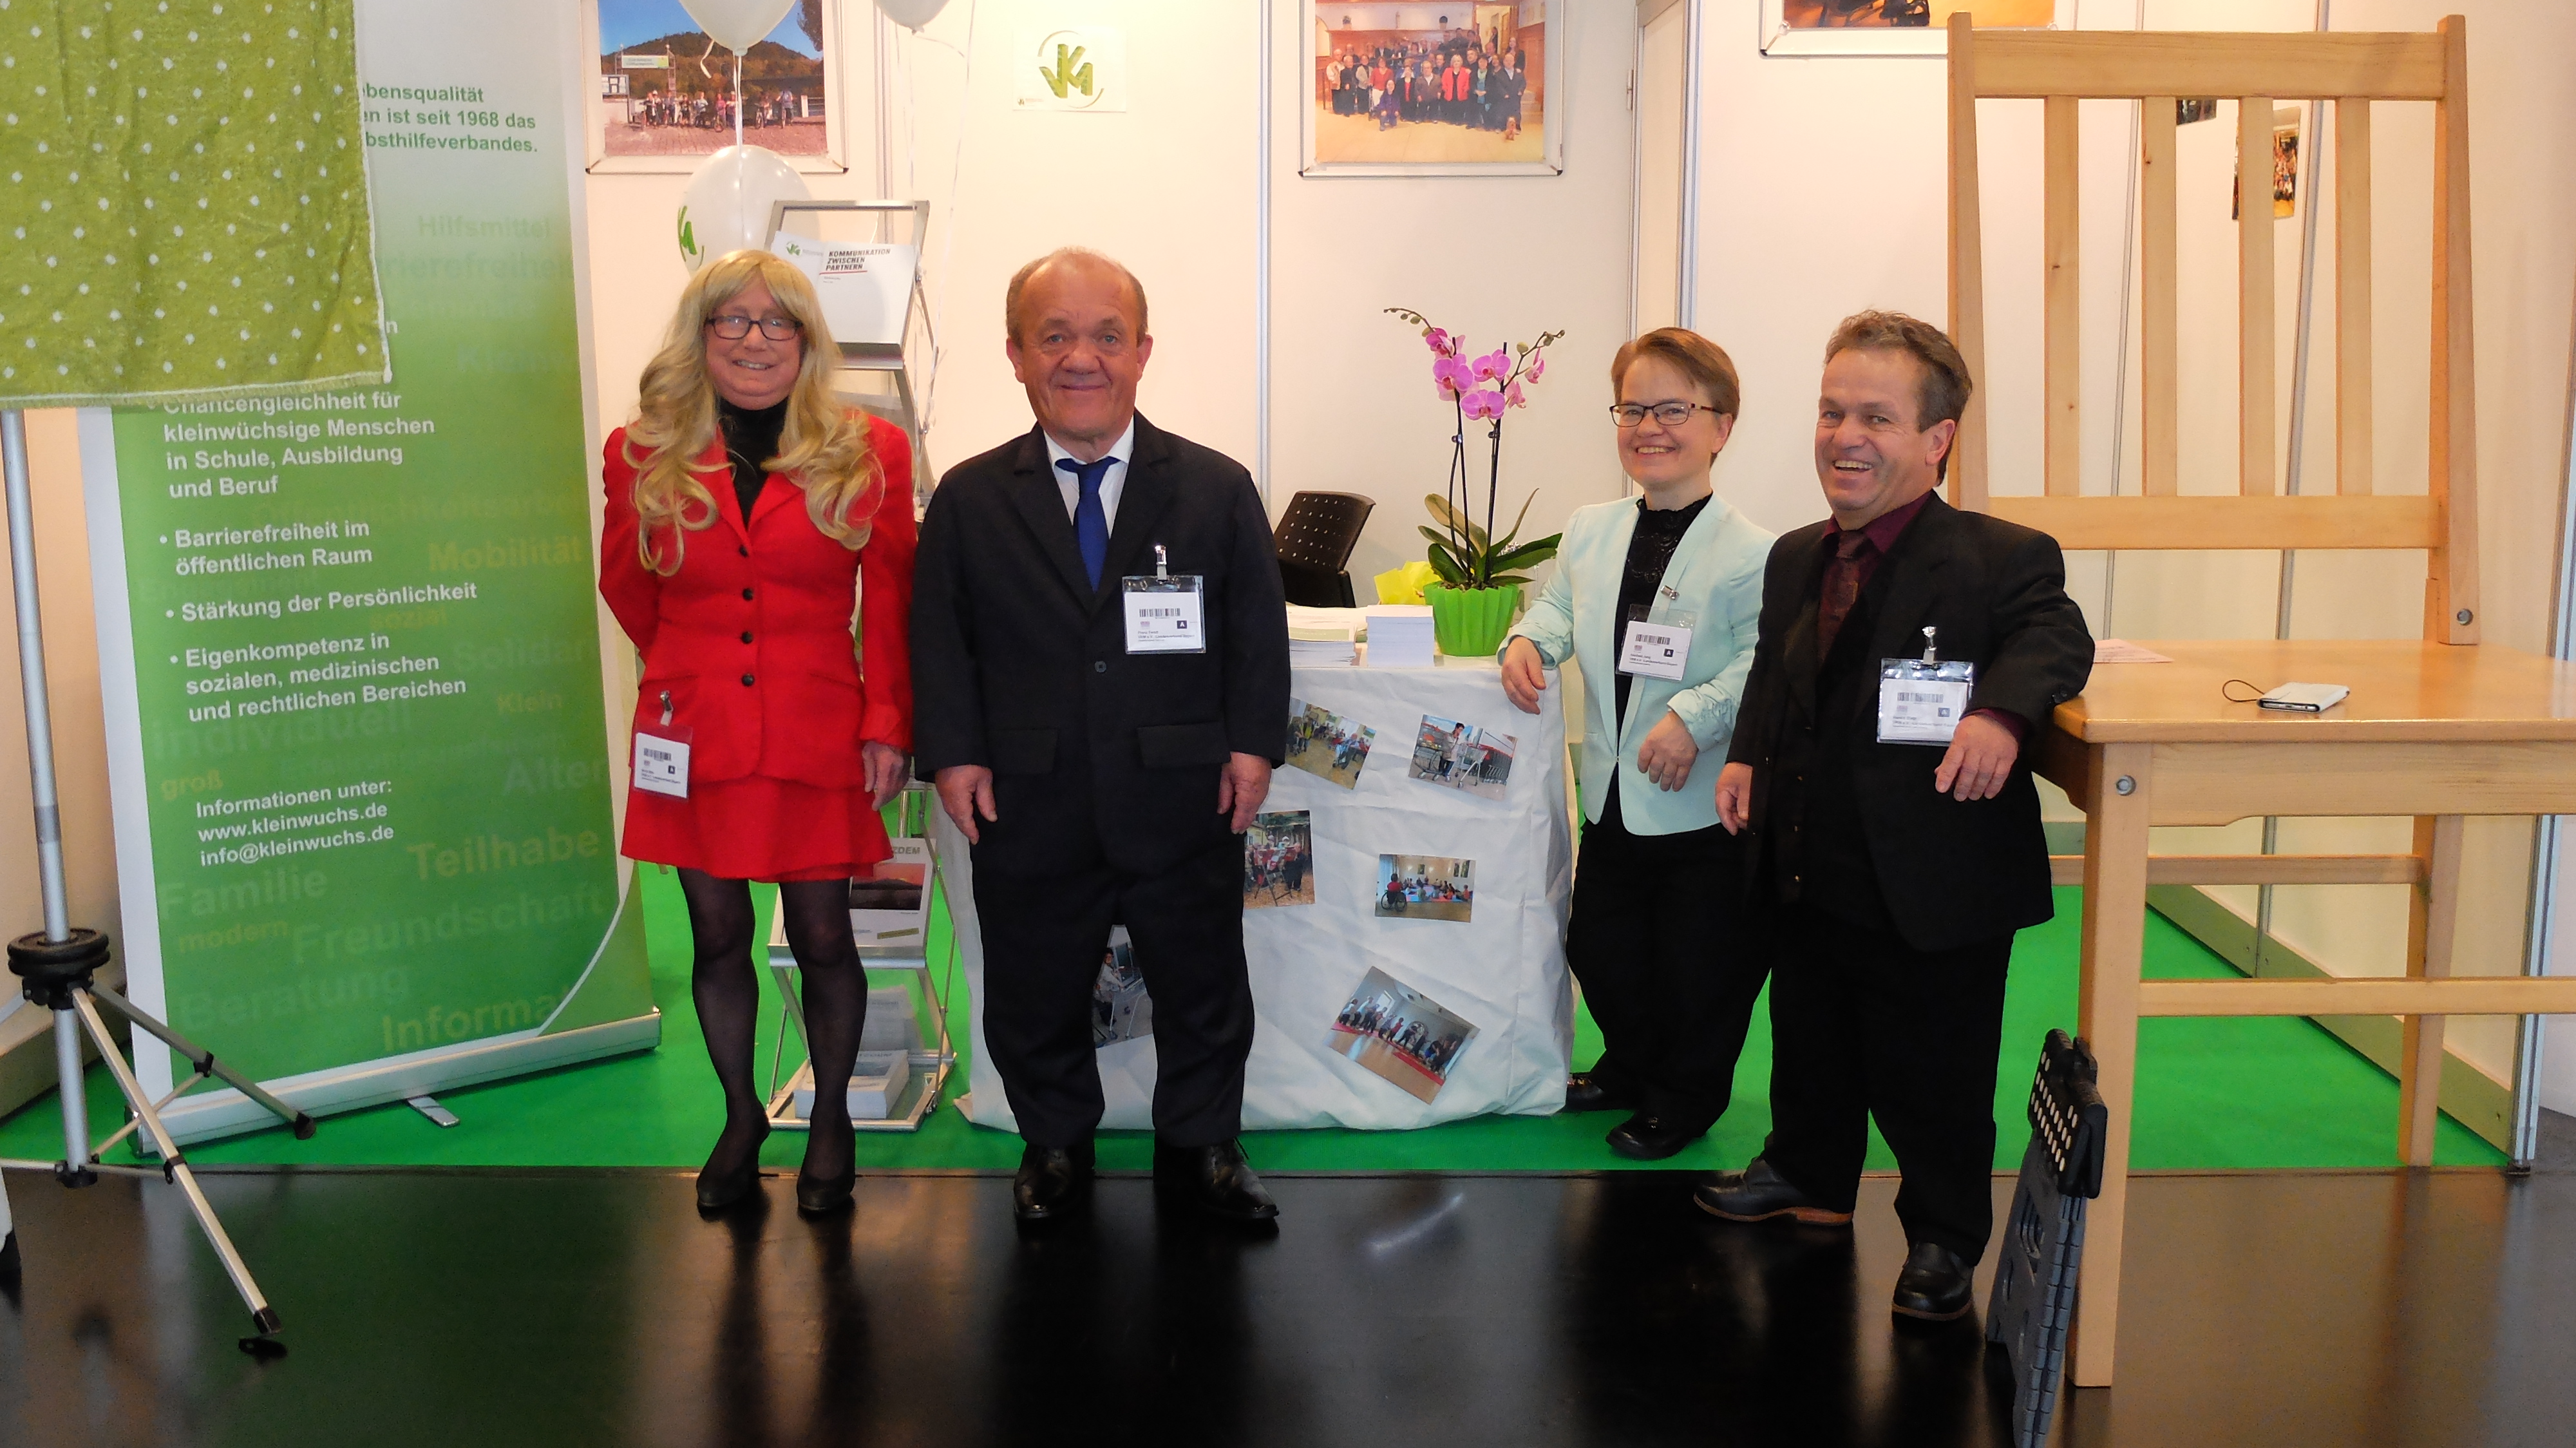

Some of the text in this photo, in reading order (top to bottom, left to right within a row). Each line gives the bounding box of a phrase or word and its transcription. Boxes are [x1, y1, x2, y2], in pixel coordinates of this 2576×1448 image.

[387, 108, 410, 124] ist
[416, 109, 451, 125] seit
[457, 110, 499, 128] 1968
[506, 113, 536, 129] das
[365, 131, 537, 152] bsthilfeverbandes.
[828, 249, 891, 258] KOMMUNIKATION
[163, 391, 402, 416] Chancengleichheit für
[164, 417, 435, 443] kleinwüchsige Menschen
[166, 445, 403, 471] in Schule, Ausbildung
[169, 475, 279, 499] und Beruf
[175, 520, 370, 548] Barrierefreiheit im
[175, 547, 373, 576] öffentlichen Raum
[427, 534, 582, 573] Mobilität
[182, 581, 477, 623] Stärkung der Persönlichkeit
[185, 633, 390, 669] Eigenkompetenz in
[185, 654, 440, 696] sozialen, medizinischen
[188, 678, 467, 723] und rechtlichen Bereichen
[497, 689, 562, 715] Klein
[160, 768, 223, 801] groß
[502, 756, 604, 797] Alter
[196, 779, 392, 819] Informationen unter:
[197, 803, 388, 843] www.kleinwuchs.de
[200, 825, 395, 867] info@kleinwuchs.de
[406, 826, 600, 881] Teilhabe
[160, 866, 328, 920] Familie
[177, 919, 289, 954] modern
[292, 880, 605, 964] Freundschaft
[178, 965, 410, 1031] Beratung
